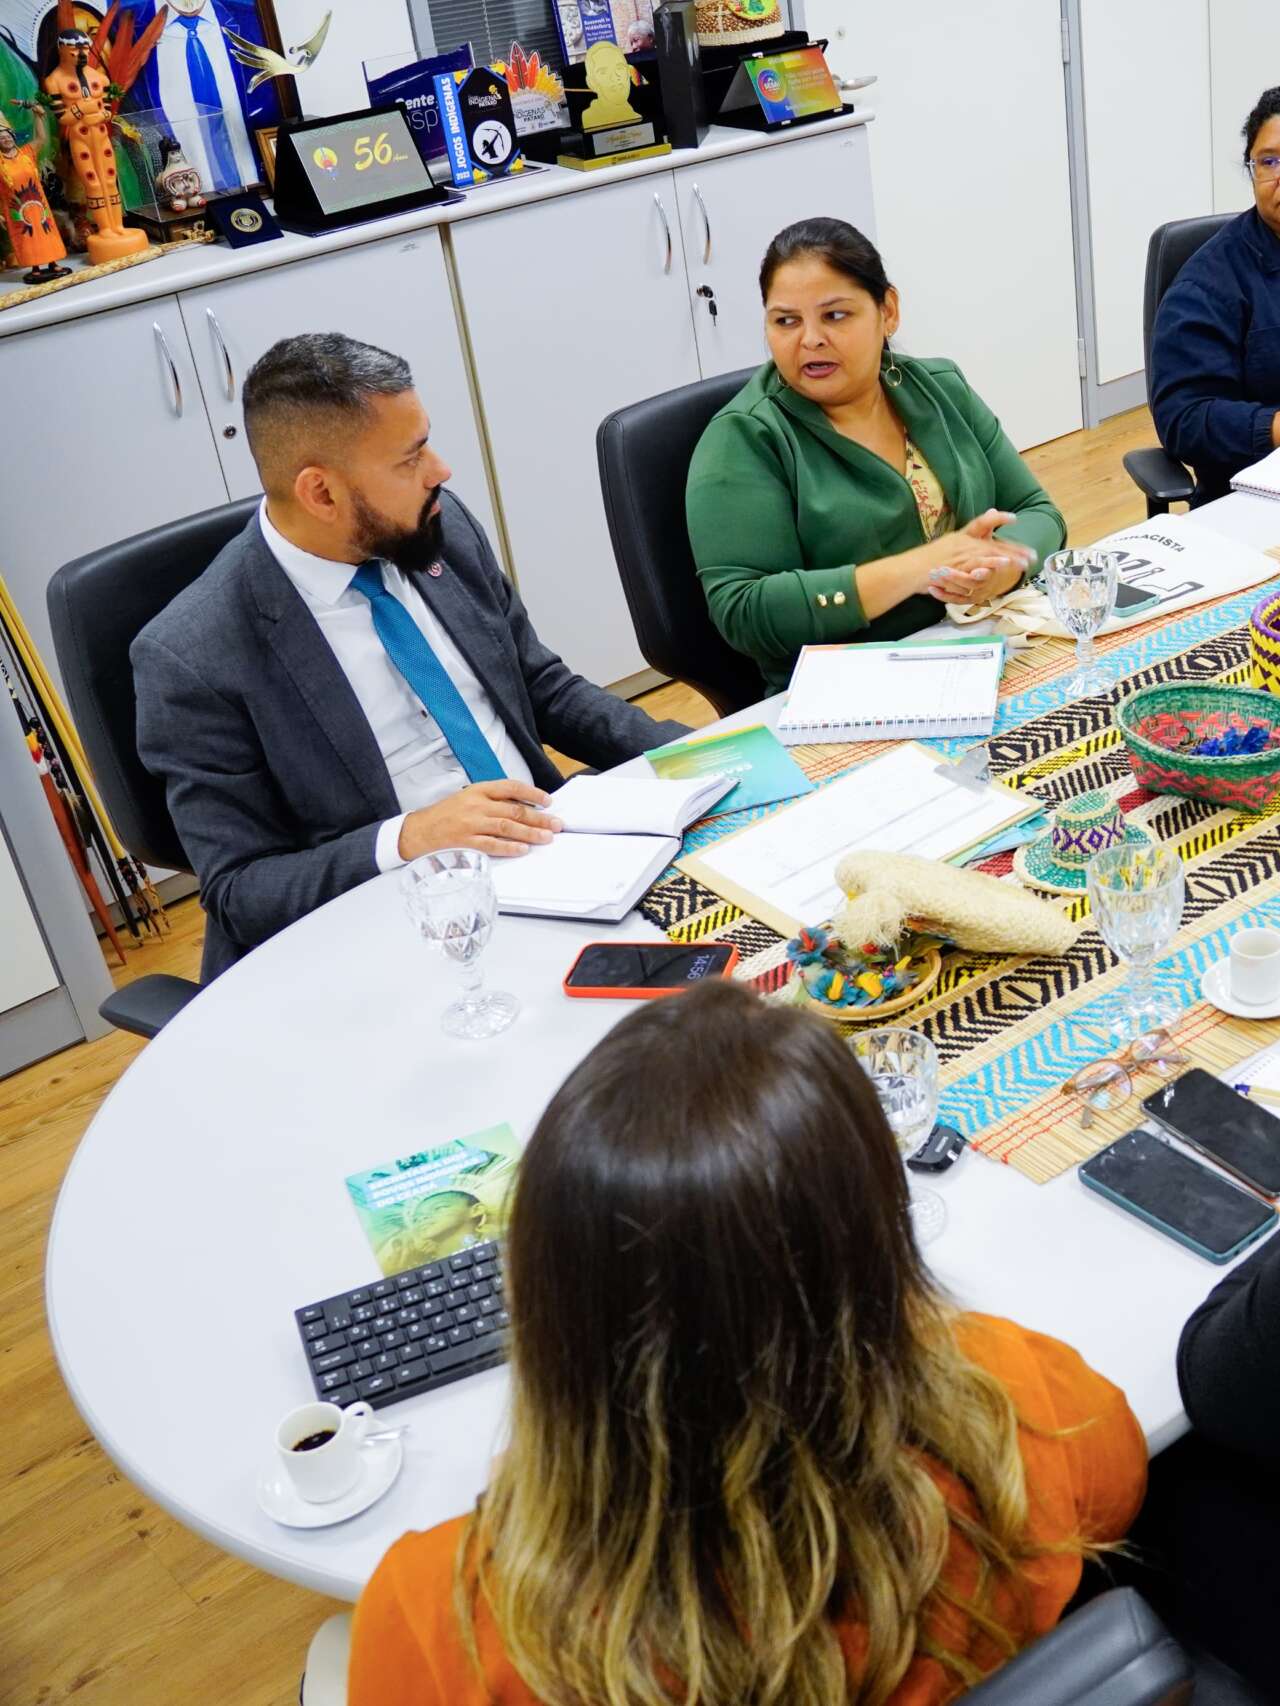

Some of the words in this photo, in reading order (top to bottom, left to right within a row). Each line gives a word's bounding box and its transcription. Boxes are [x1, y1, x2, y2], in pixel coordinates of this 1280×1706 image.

[441, 77, 461, 134] INDÍGENAS
[354, 132, 392, 171] 56
[453, 136, 467, 169] JOGOS
[687, 954, 710, 980] 14:56
